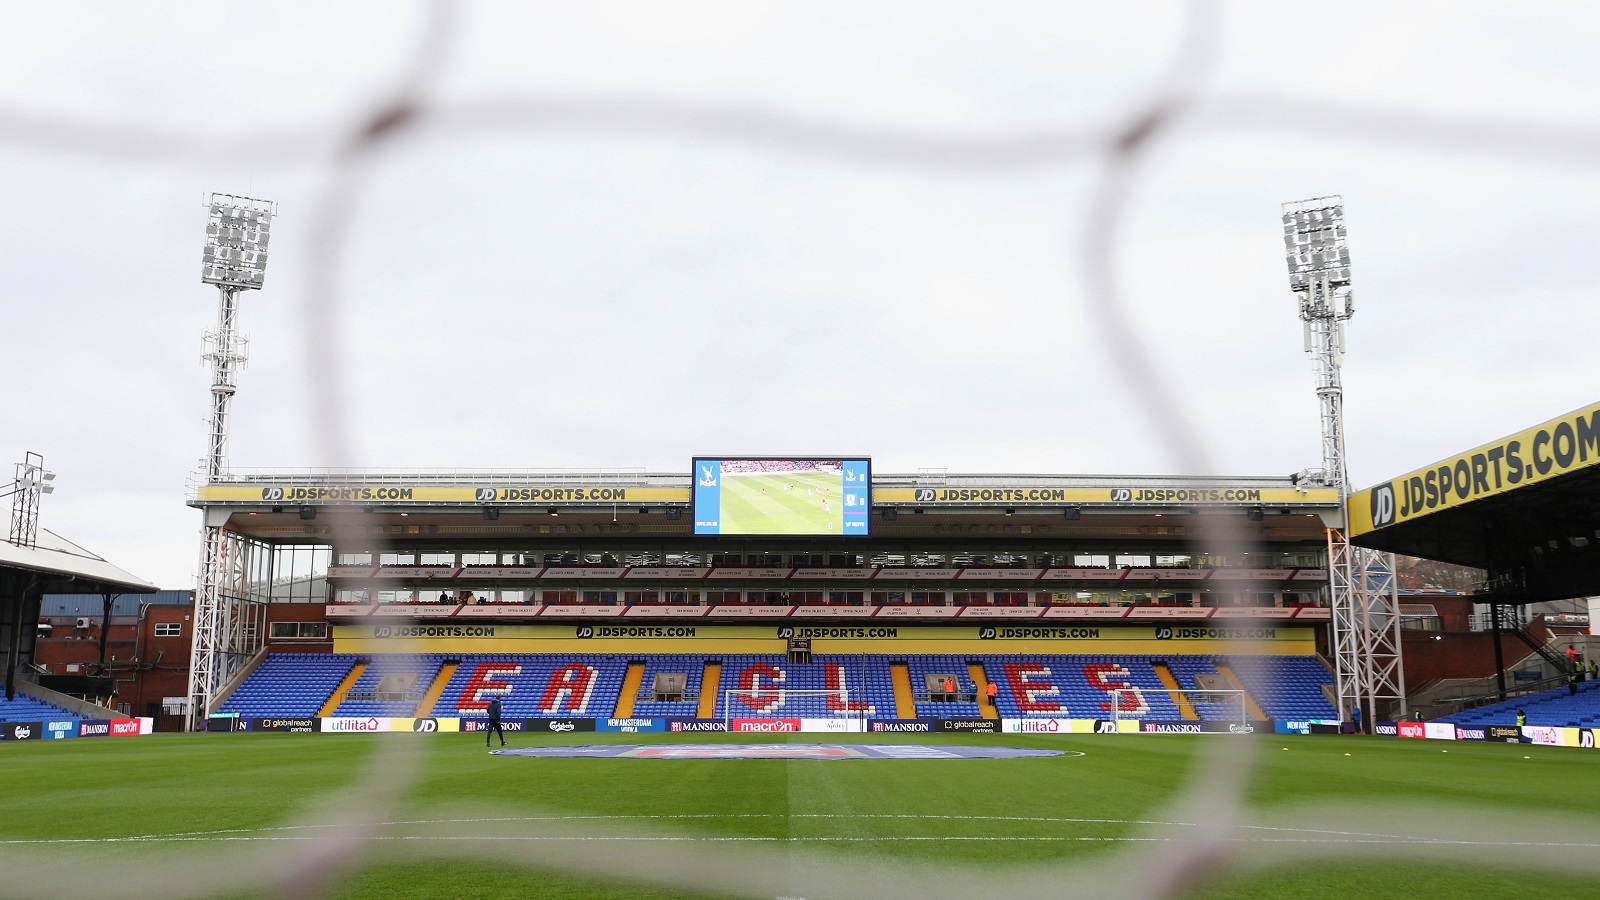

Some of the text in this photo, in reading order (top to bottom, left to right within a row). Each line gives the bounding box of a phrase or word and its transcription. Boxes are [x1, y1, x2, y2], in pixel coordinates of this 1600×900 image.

[265, 488, 413, 500] JD JDSPORTS.COM
[478, 489, 626, 501] JD JDSPORTS.COM
[918, 490, 1065, 501] JD JDSPORTS.COM
[1113, 490, 1261, 501] JD JDSPORTS.COM
[1374, 486, 1393, 527] JD
[394, 627, 495, 637] JDSPORTS.COM
[578, 628, 696, 637] JD JDSPORTS.COM
[797, 629, 898, 637] JDSPORTS.COM
[981, 629, 1100, 638] JD JDSPORTS.COM
[1158, 629, 1276, 638] JD JDSPORTS.COM
[113, 721, 137, 733] macron
[331, 719, 367, 731] utilita
[416, 719, 436, 732] JD
[549, 721, 575, 732] Carlsberg
[607, 718, 652, 727] NEW AMSTERDAM
[682, 722, 726, 731] MANSION
[741, 720, 793, 732] macron
[884, 723, 929, 732] MANSION
[1013, 720, 1047, 732] utilita
[1096, 721, 1116, 733] JD
[87, 724, 109, 736] MANSION
[1157, 724, 1201, 733] MANSION
[1375, 726, 1397, 735] ANSION
[1400, 725, 1423, 738] macron
[1462, 729, 1485, 740] MANSION
[1580, 730, 1594, 748] JD
